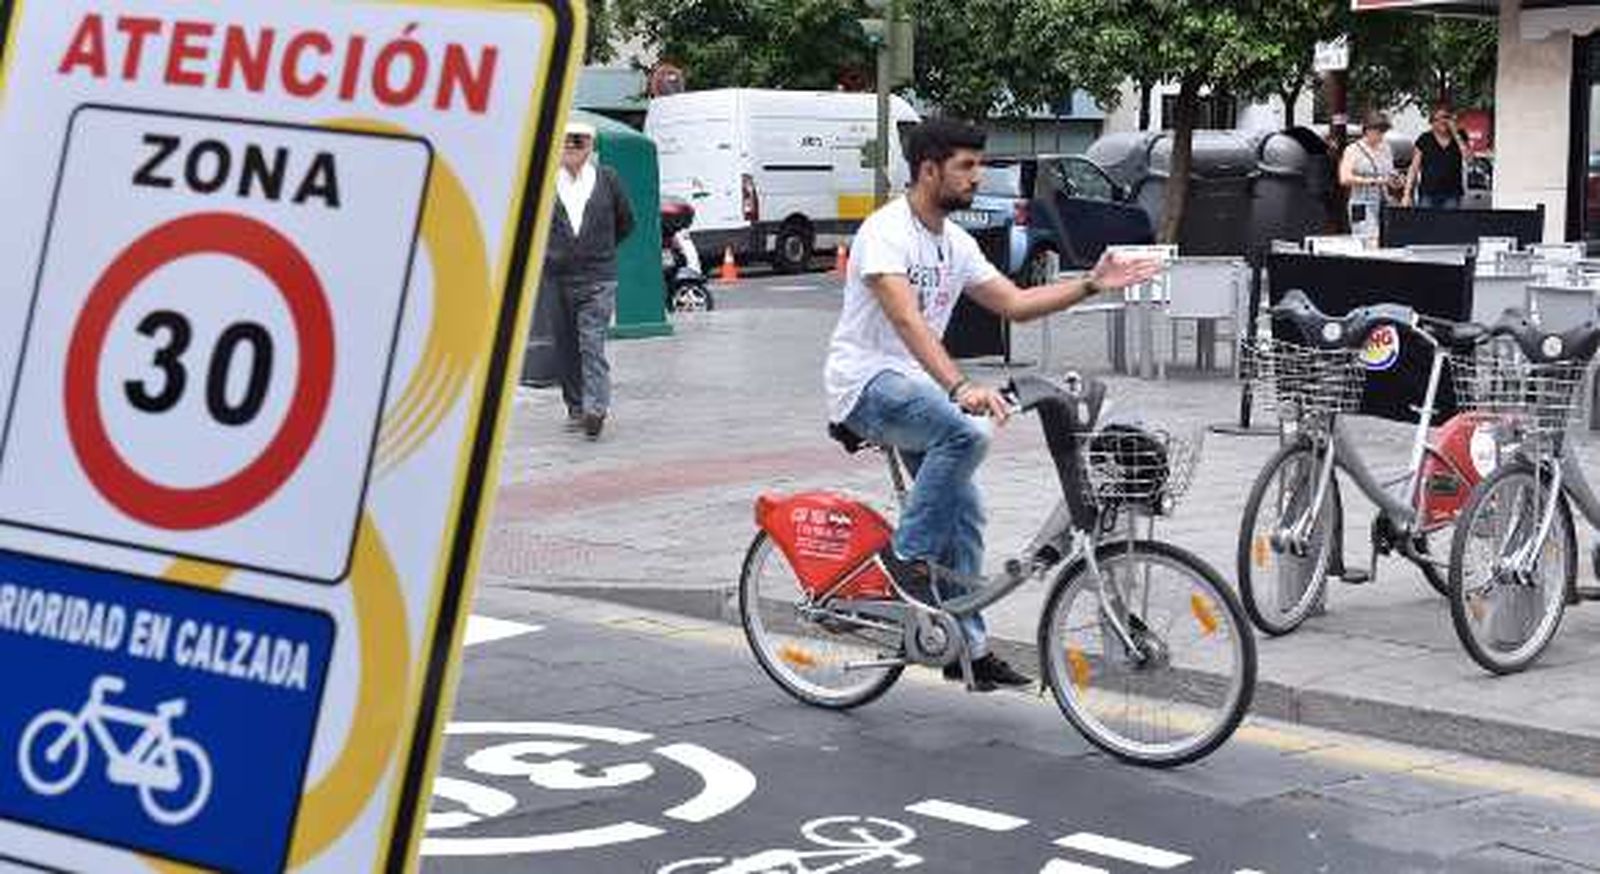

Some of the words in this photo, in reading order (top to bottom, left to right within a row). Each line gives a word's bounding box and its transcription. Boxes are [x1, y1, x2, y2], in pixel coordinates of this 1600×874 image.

[59, 14, 497, 114] ATENCIÓN
[132, 133, 341, 208] ZONA
[123, 309, 274, 427] 30
[0, 584, 126, 650] RIORIDAD
[128, 610, 172, 662] EN
[174, 619, 309, 690] CALZADA
